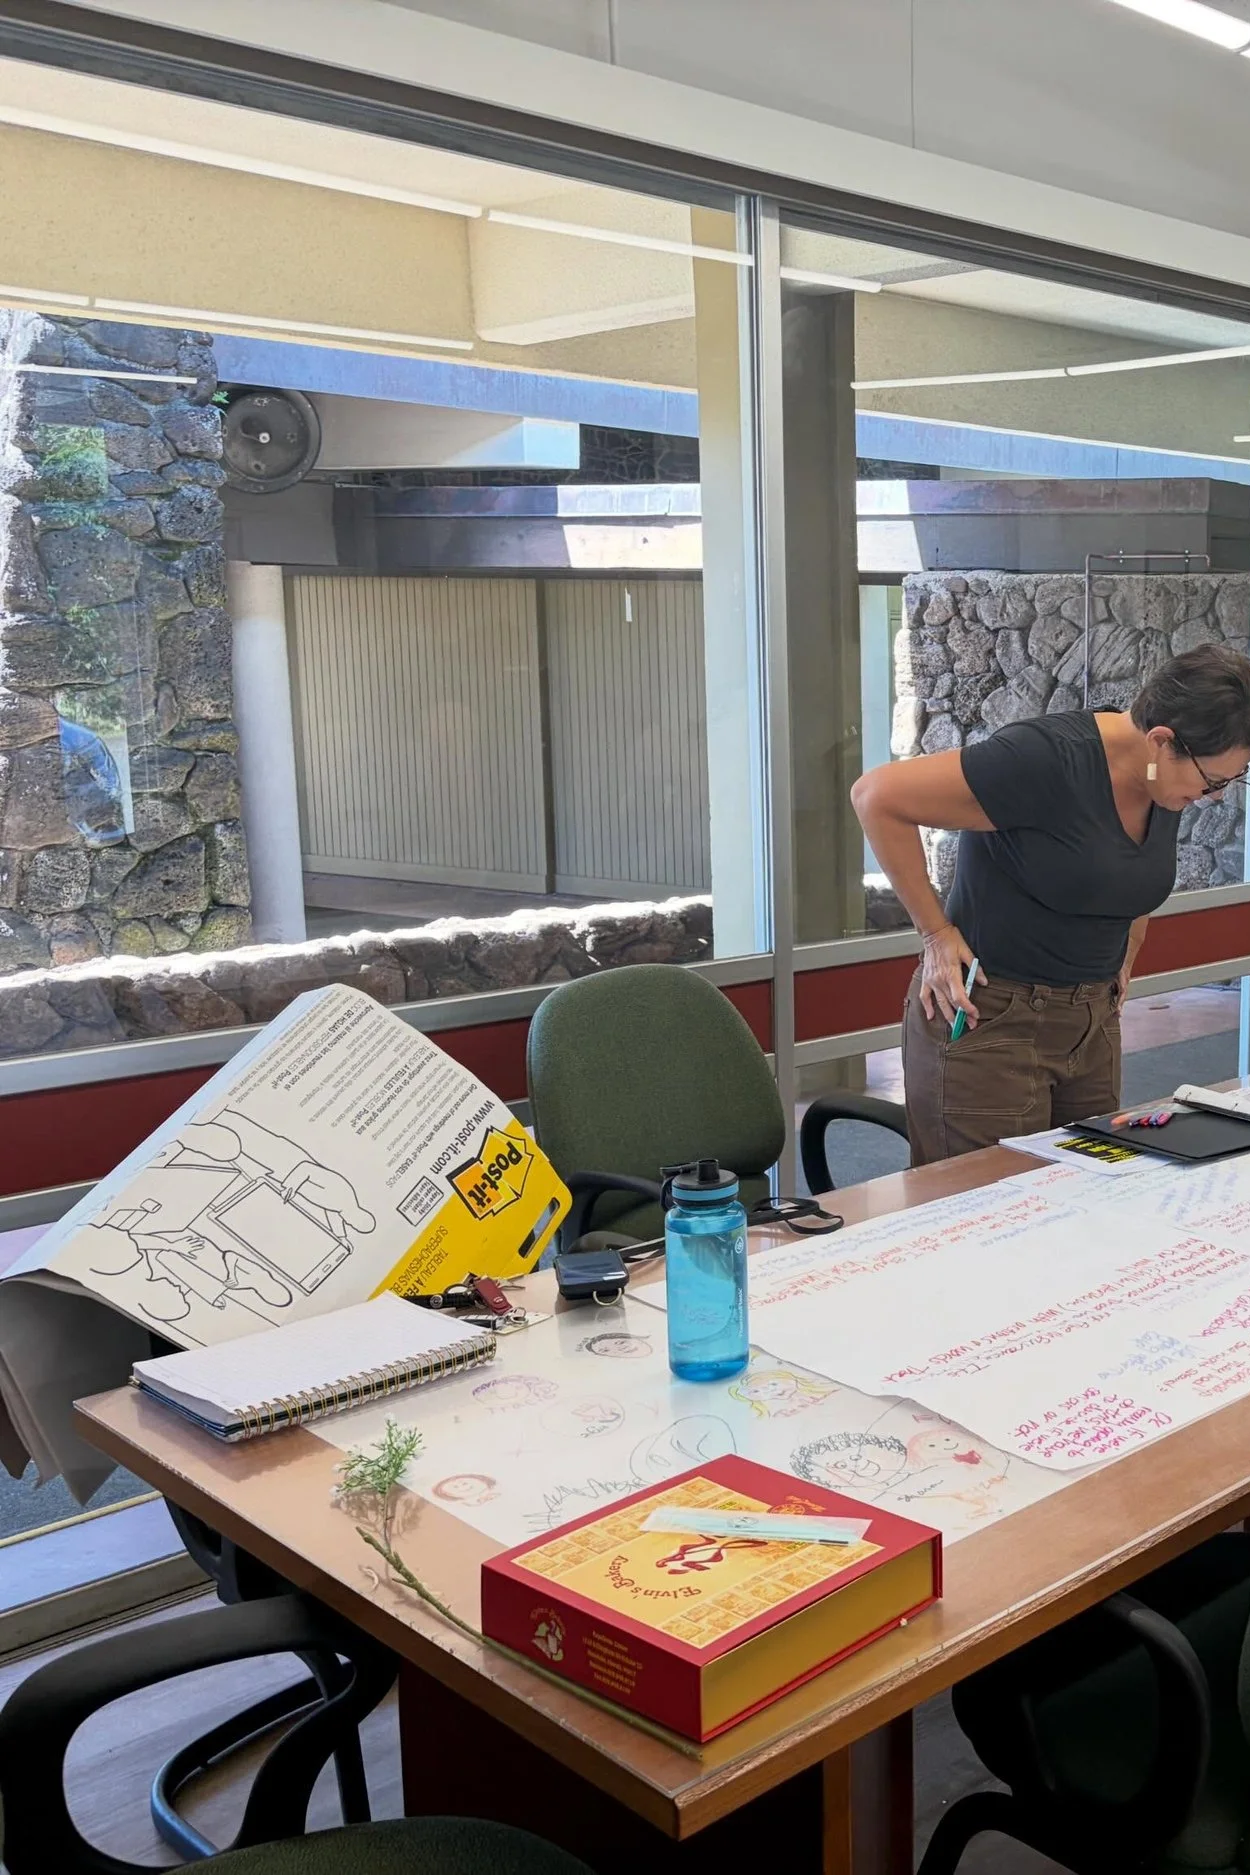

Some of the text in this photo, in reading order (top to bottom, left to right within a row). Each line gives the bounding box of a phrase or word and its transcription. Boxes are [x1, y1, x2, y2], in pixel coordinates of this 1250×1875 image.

[328, 1017, 346, 1032] HOJAS
[382, 1066, 406, 1092] FEUILLES
[431, 1101, 493, 1173] www.post-it.com
[433, 1113, 451, 1132] meetings
[399, 1226, 447, 1285] SUPERADHESIVAS
[420, 1249, 448, 1280] TABLEAU
[603, 1553, 702, 1601] Elvin's Bakery
